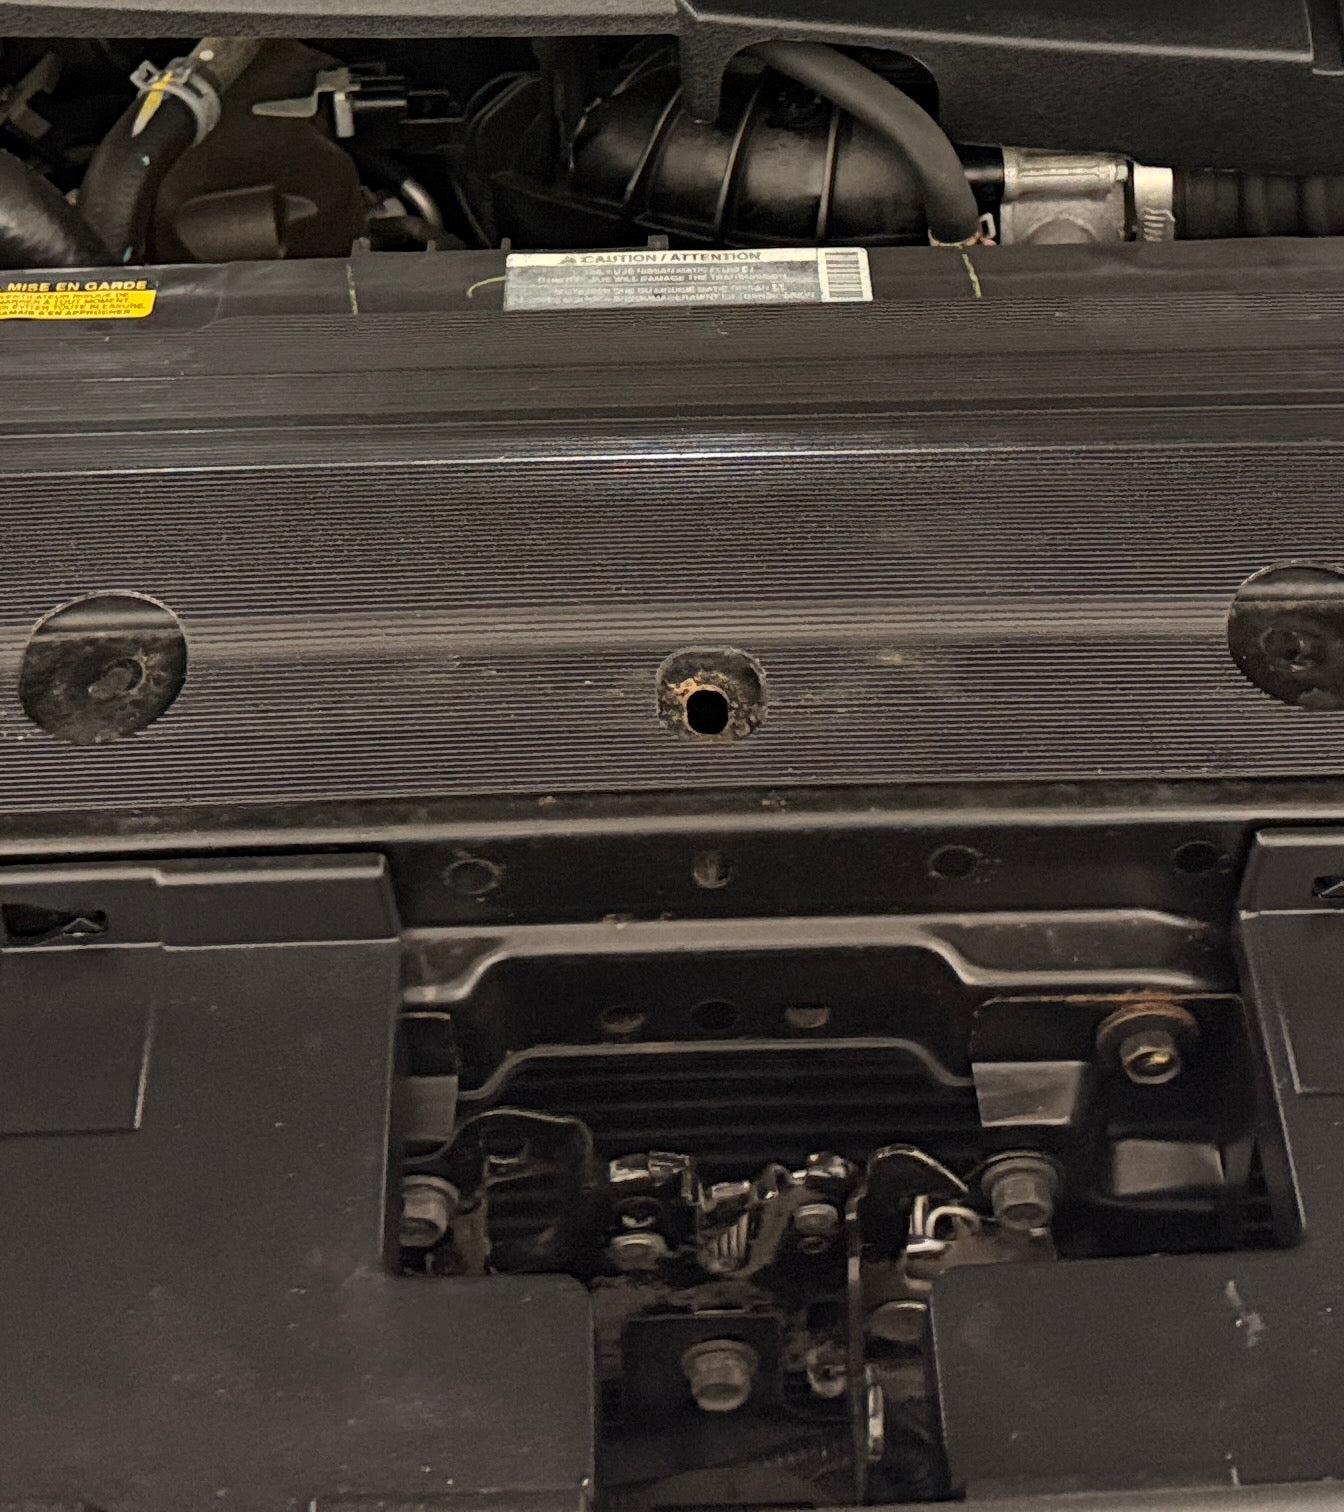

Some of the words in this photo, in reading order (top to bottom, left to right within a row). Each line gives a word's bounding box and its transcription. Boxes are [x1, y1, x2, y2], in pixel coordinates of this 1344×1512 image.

[581, 254, 657, 263] CAUTION
[670, 251, 761, 262] ATTENTION
[7, 282, 51, 292] MISE
[56, 281, 80, 291] EN
[84, 280, 148, 291] GARDE
